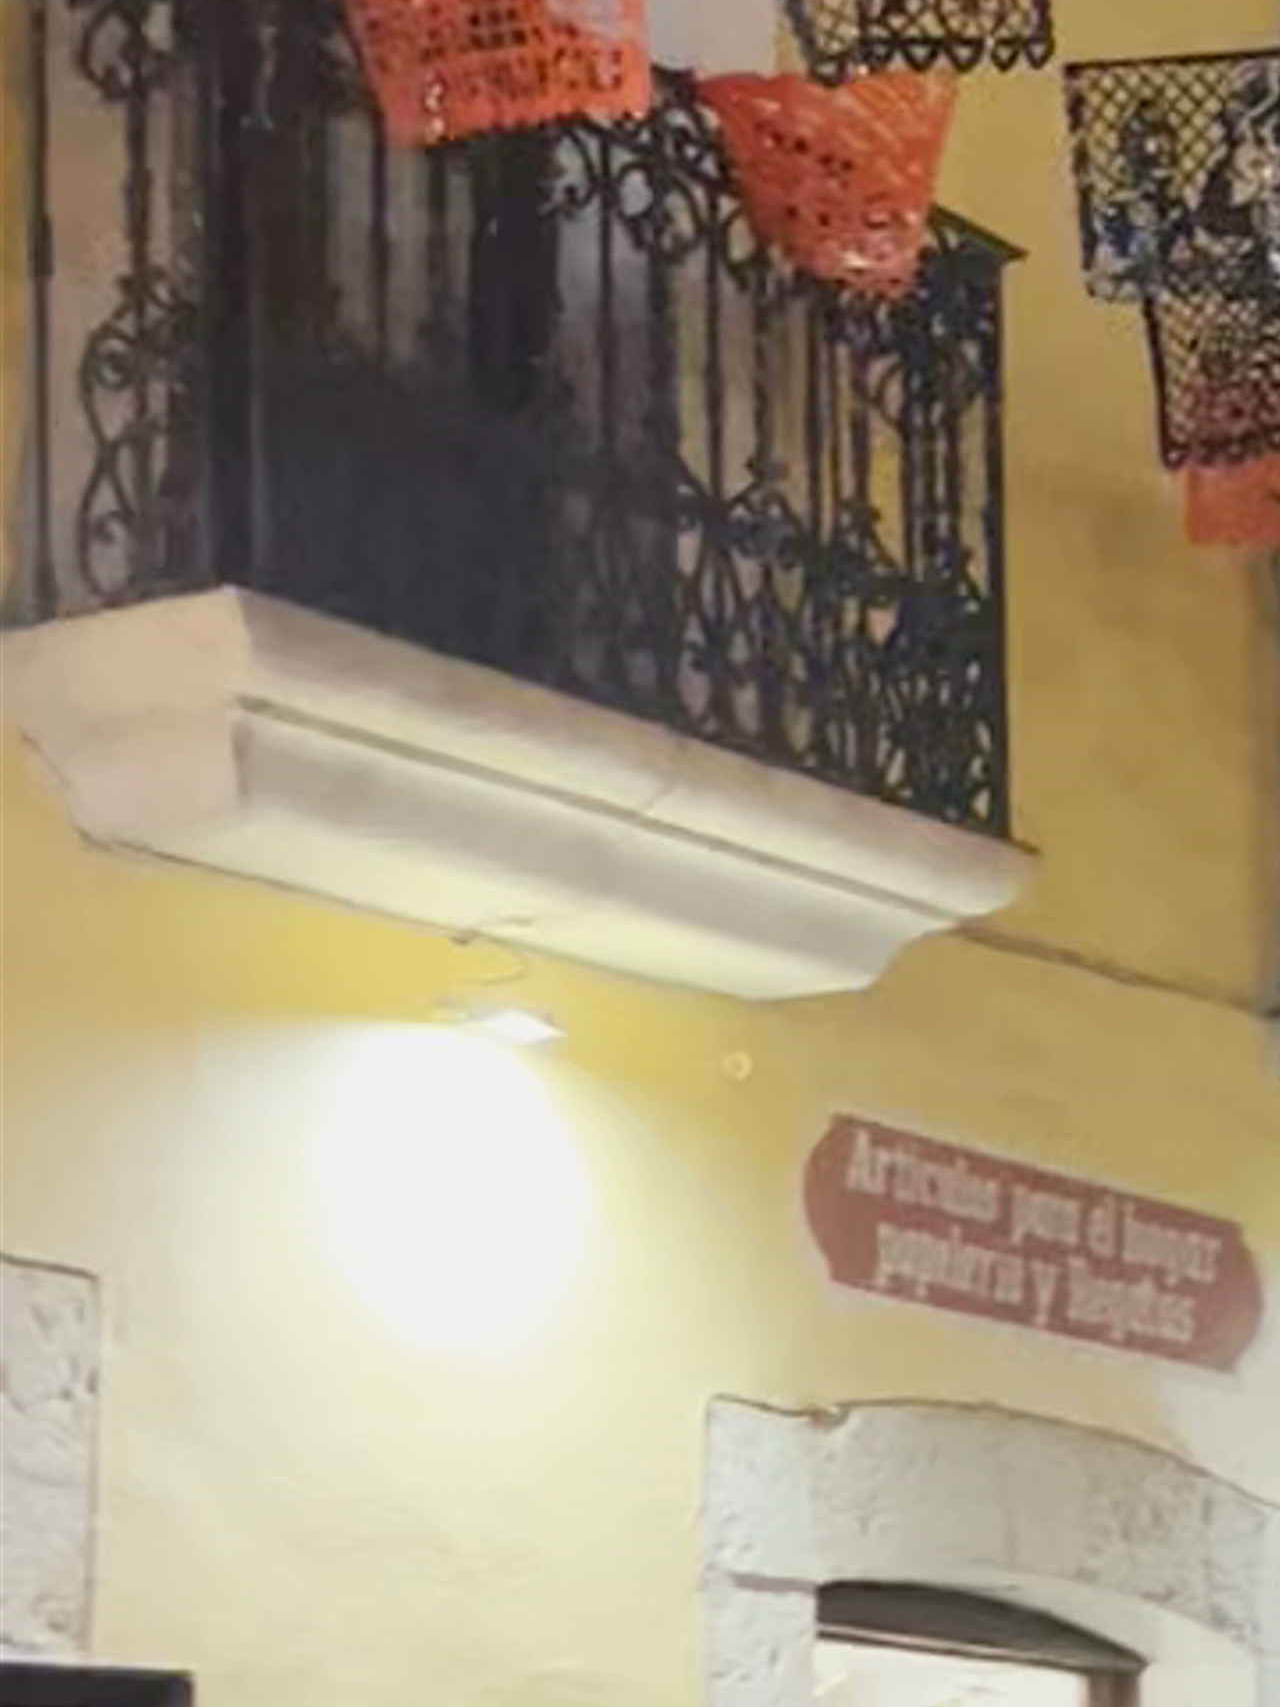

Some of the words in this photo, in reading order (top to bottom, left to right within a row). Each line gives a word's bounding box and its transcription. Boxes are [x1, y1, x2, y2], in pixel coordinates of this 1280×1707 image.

[1010, 1186, 1082, 1246] para
[1088, 1195, 1116, 1256] el
[1031, 1261, 1060, 1328] y
